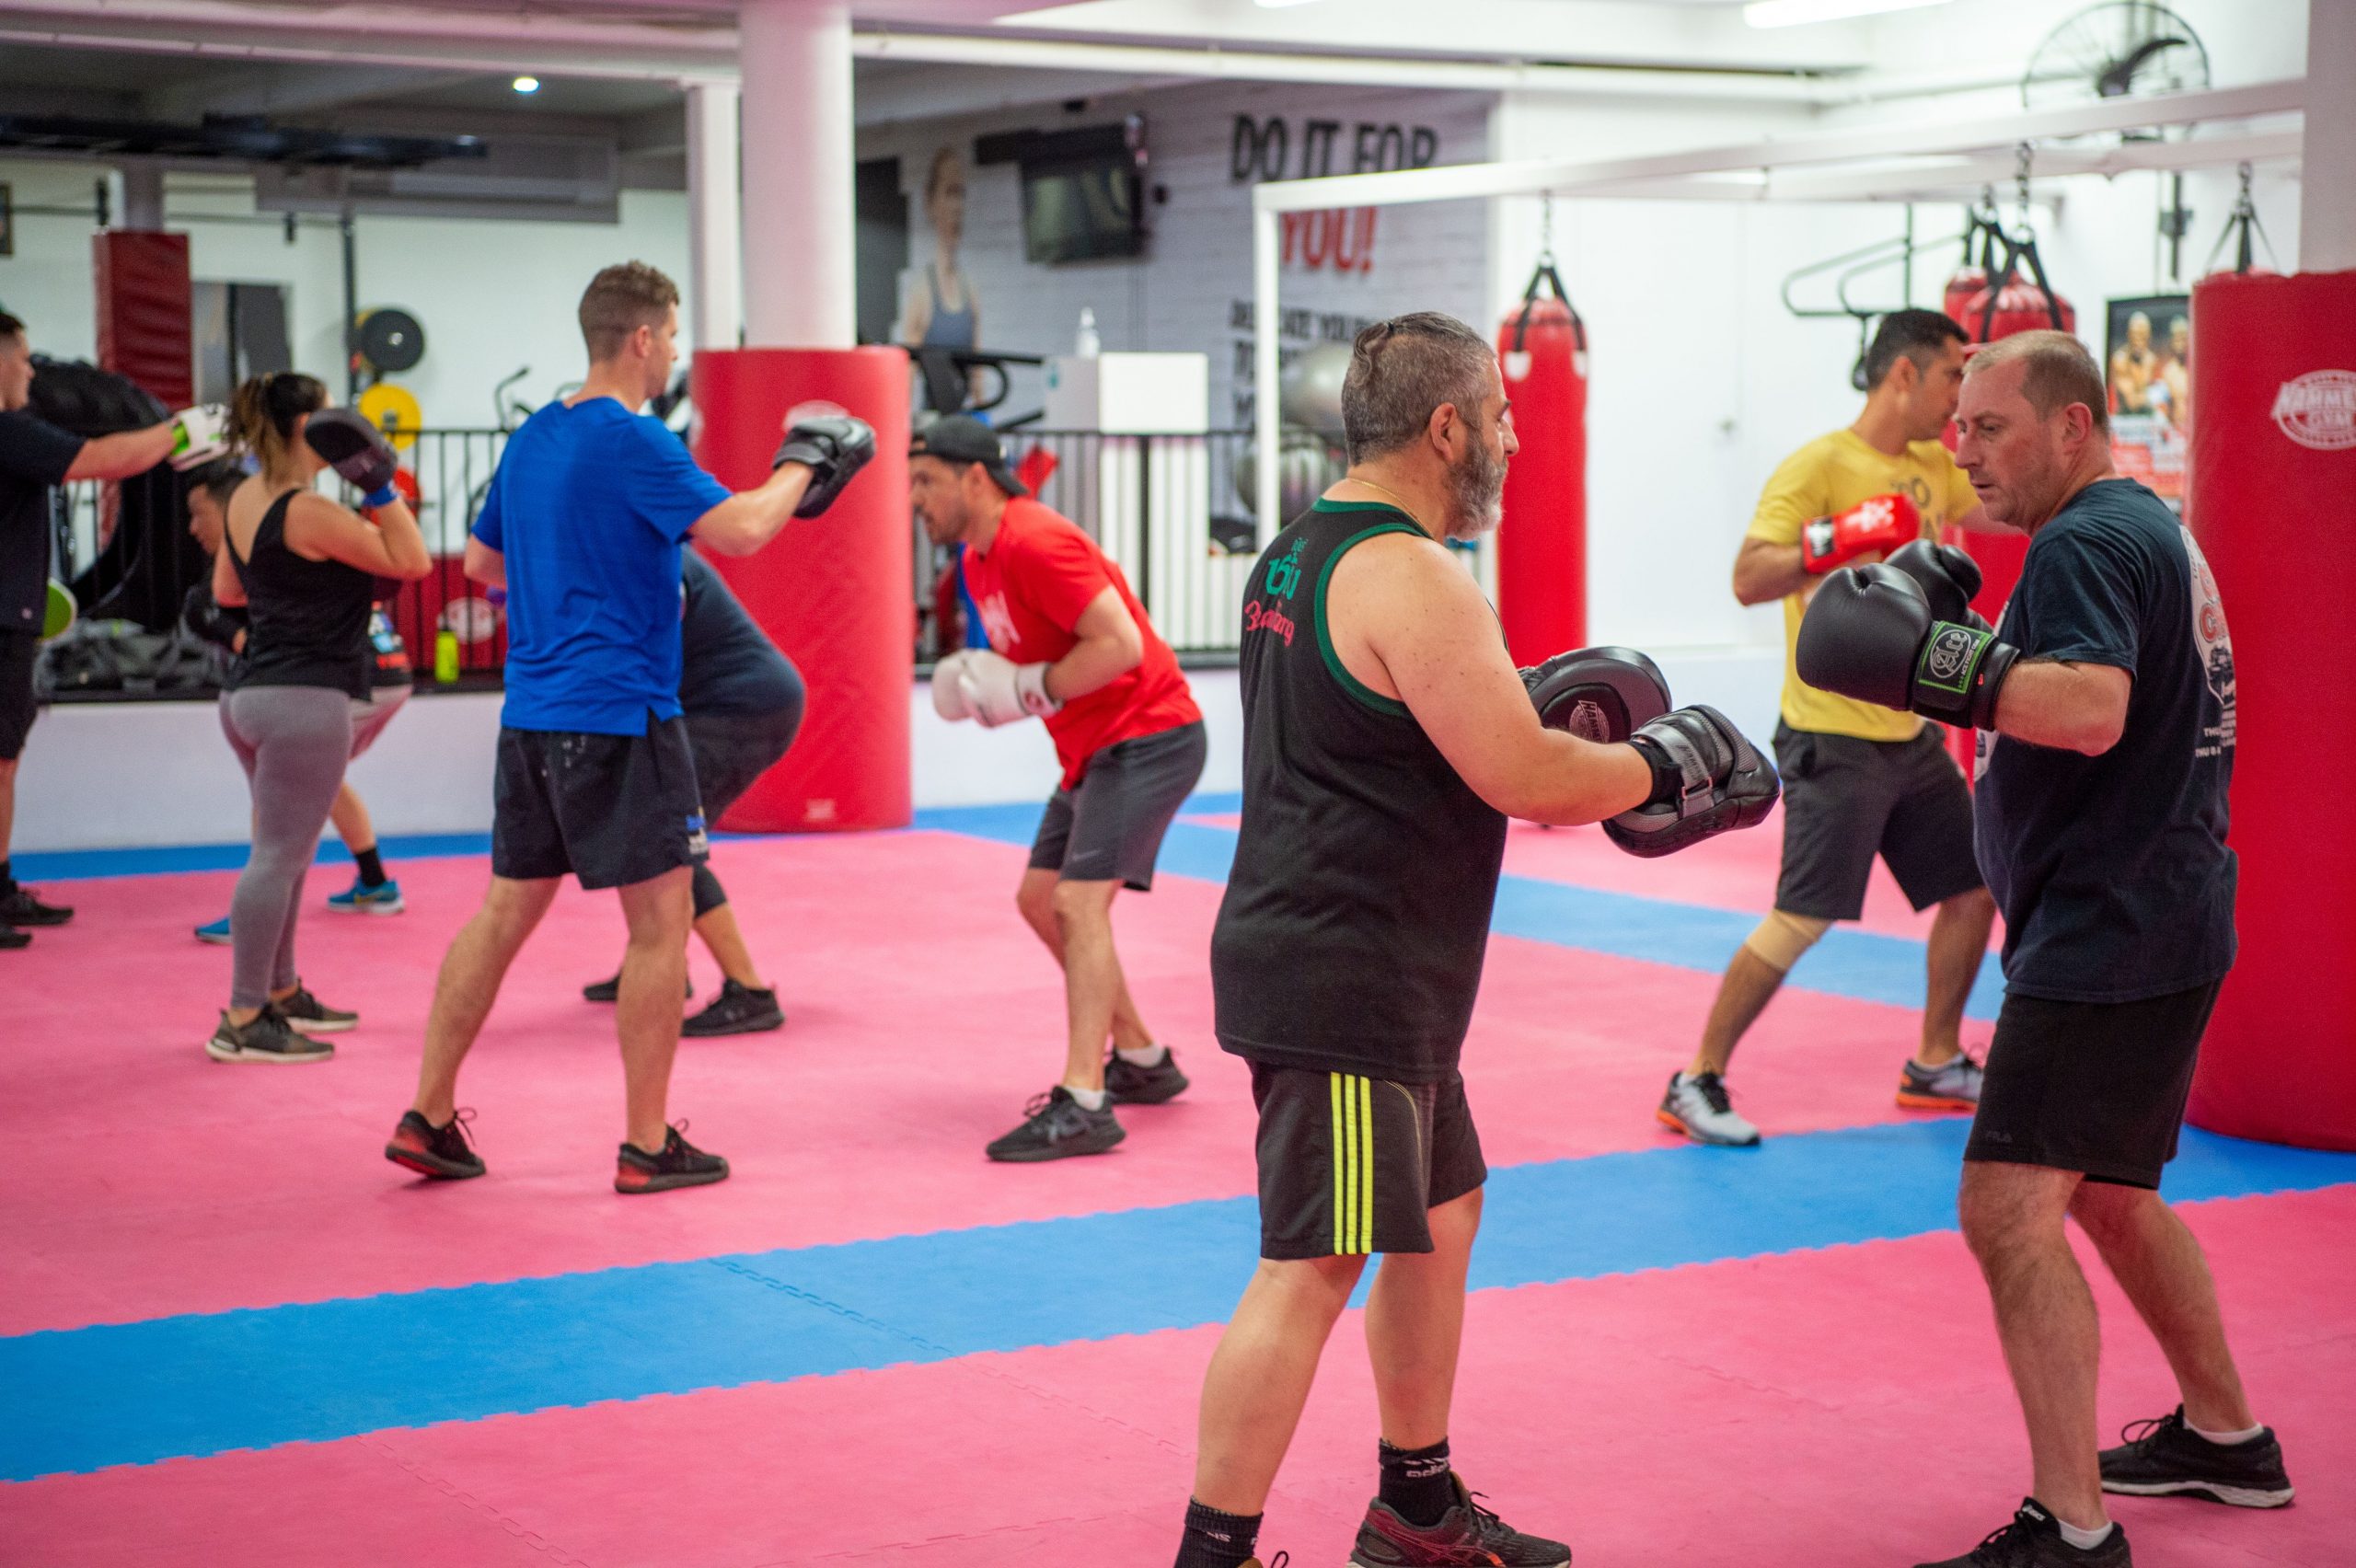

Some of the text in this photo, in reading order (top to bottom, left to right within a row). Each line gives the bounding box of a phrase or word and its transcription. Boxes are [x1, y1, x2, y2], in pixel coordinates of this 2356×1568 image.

[1232, 113, 1438, 182] DO IT FOR
[1281, 205, 1379, 273] YOU!
